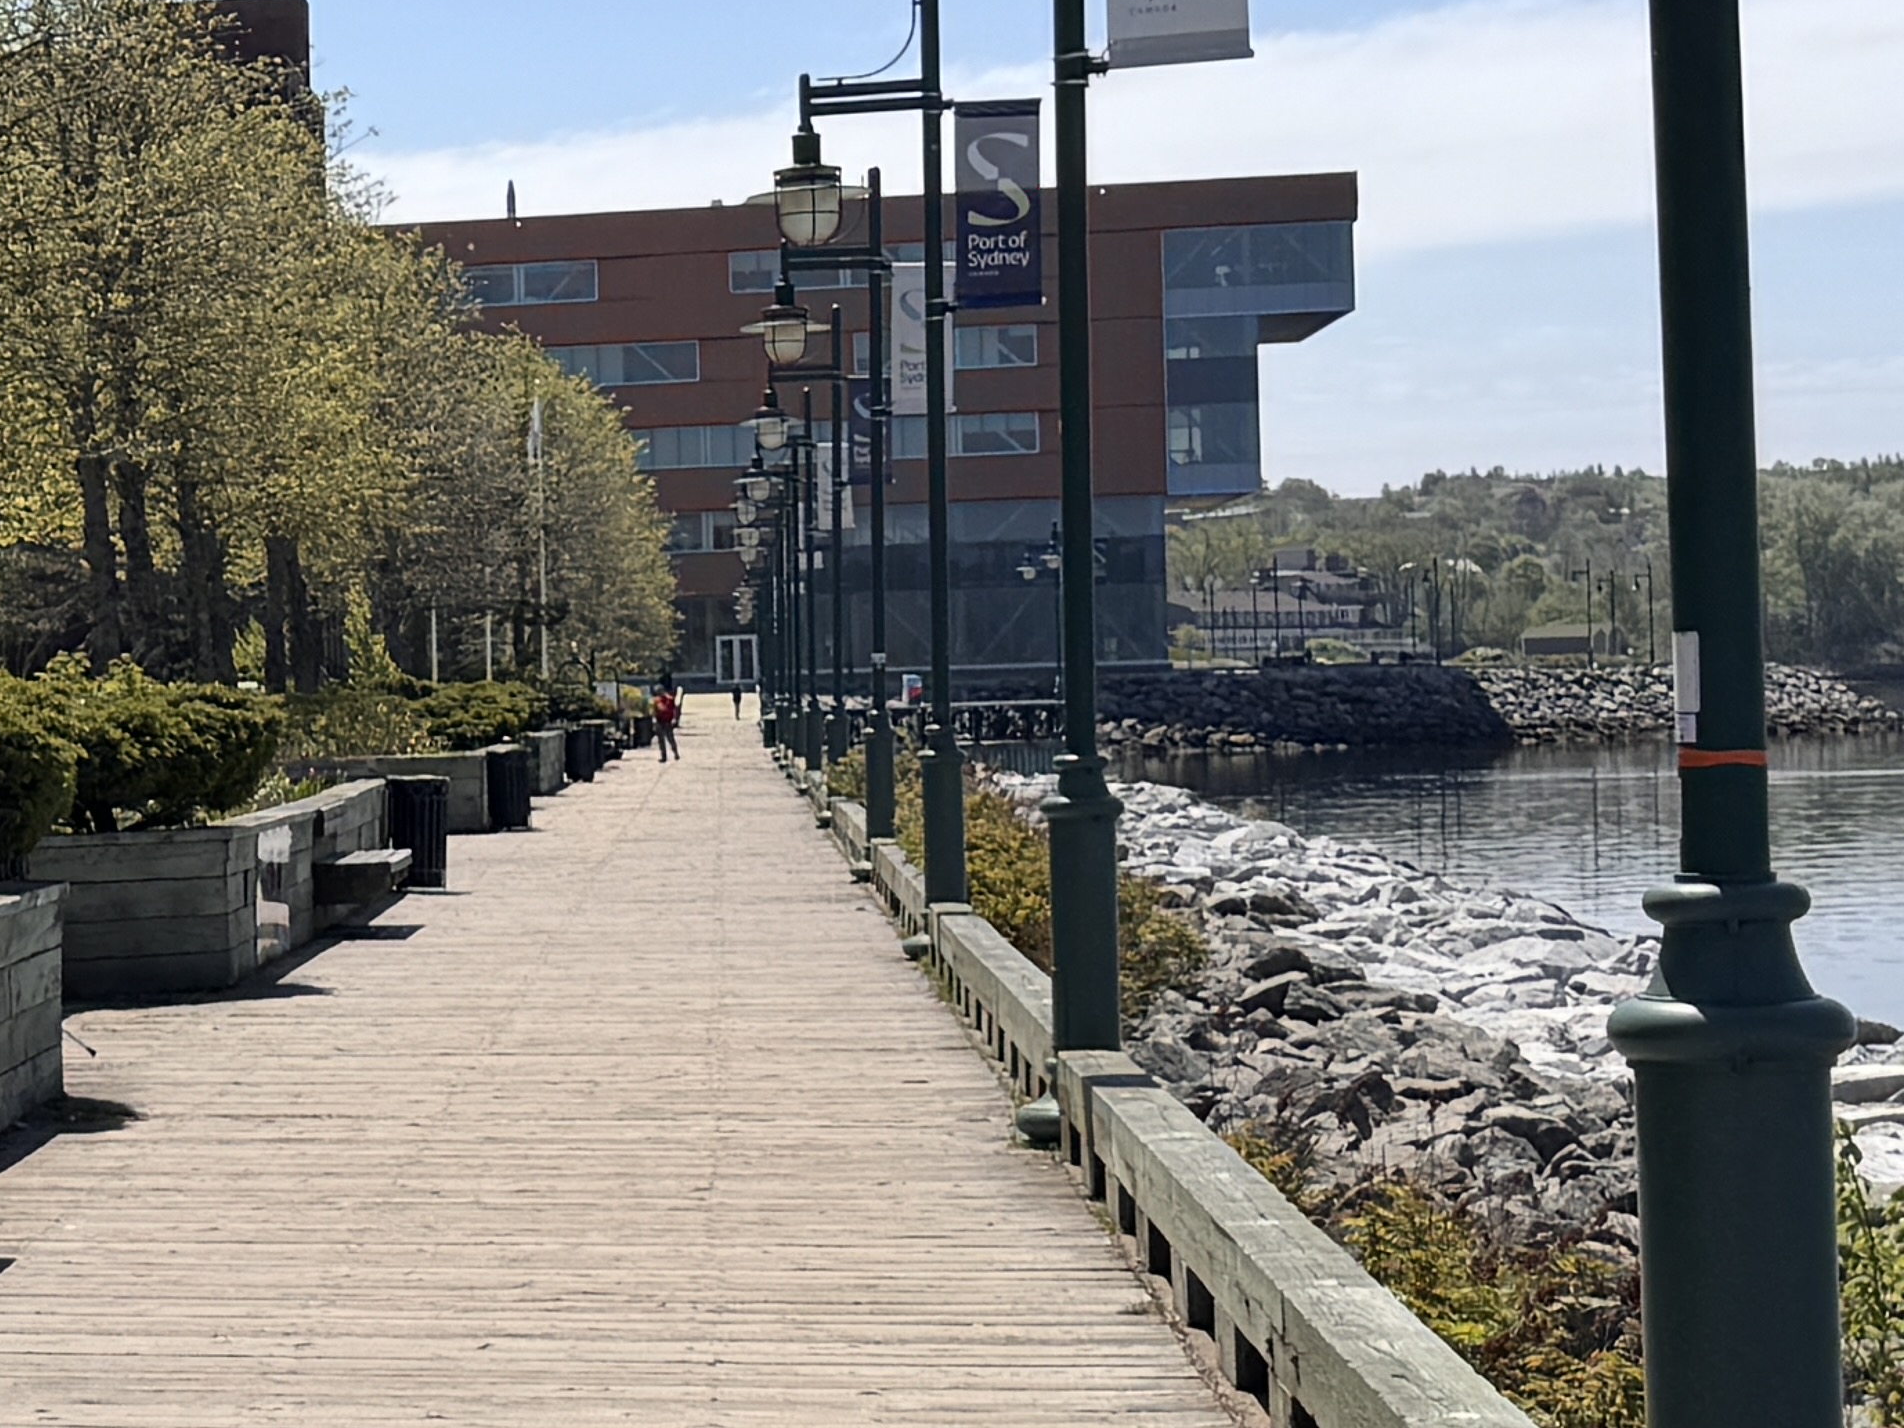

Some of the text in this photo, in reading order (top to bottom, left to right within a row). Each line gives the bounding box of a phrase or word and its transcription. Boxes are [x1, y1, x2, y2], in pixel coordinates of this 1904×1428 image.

[968, 230, 1028, 250] Port of
[968, 250, 1030, 269] Sydney
